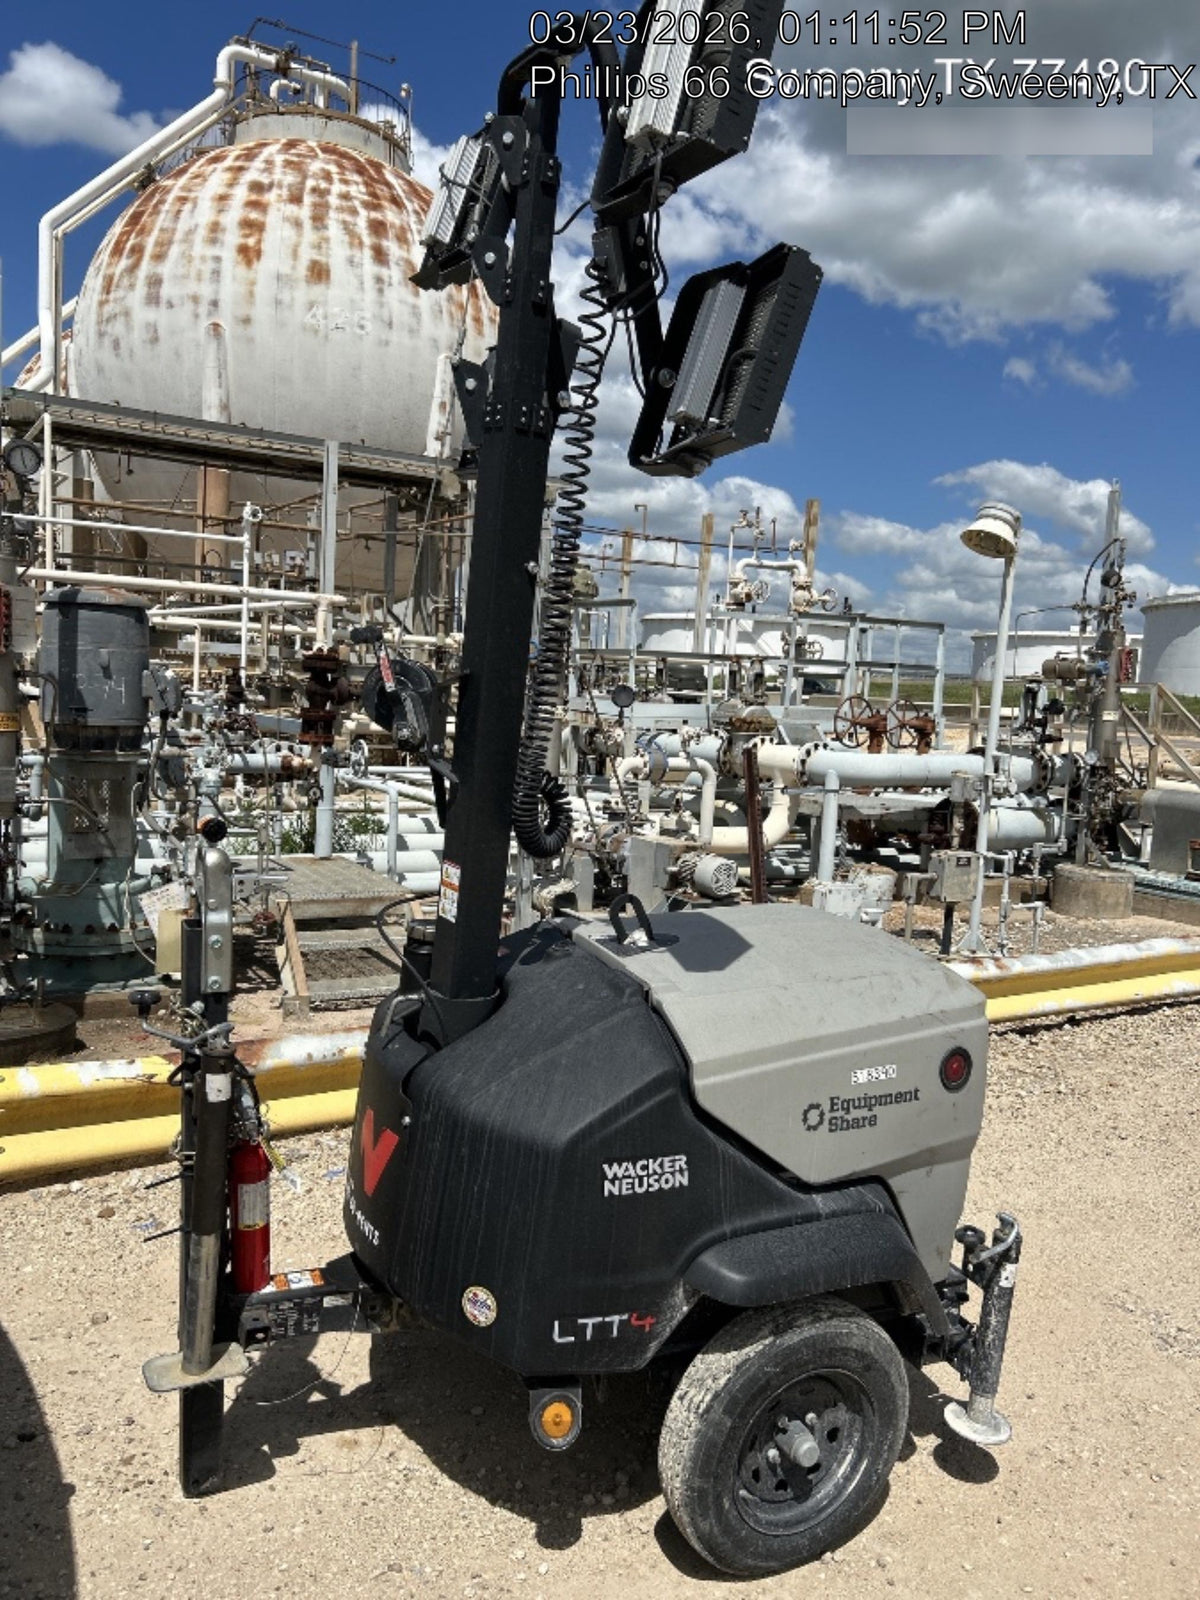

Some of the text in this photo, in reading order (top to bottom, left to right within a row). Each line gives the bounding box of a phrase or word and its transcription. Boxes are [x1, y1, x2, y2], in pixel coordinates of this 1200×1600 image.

[828, 1087, 920, 1115] Equipment
[828, 1114, 878, 1133] Share
[602, 1154, 689, 1180] WACKER
[603, 1170, 690, 1198] NEUSON
